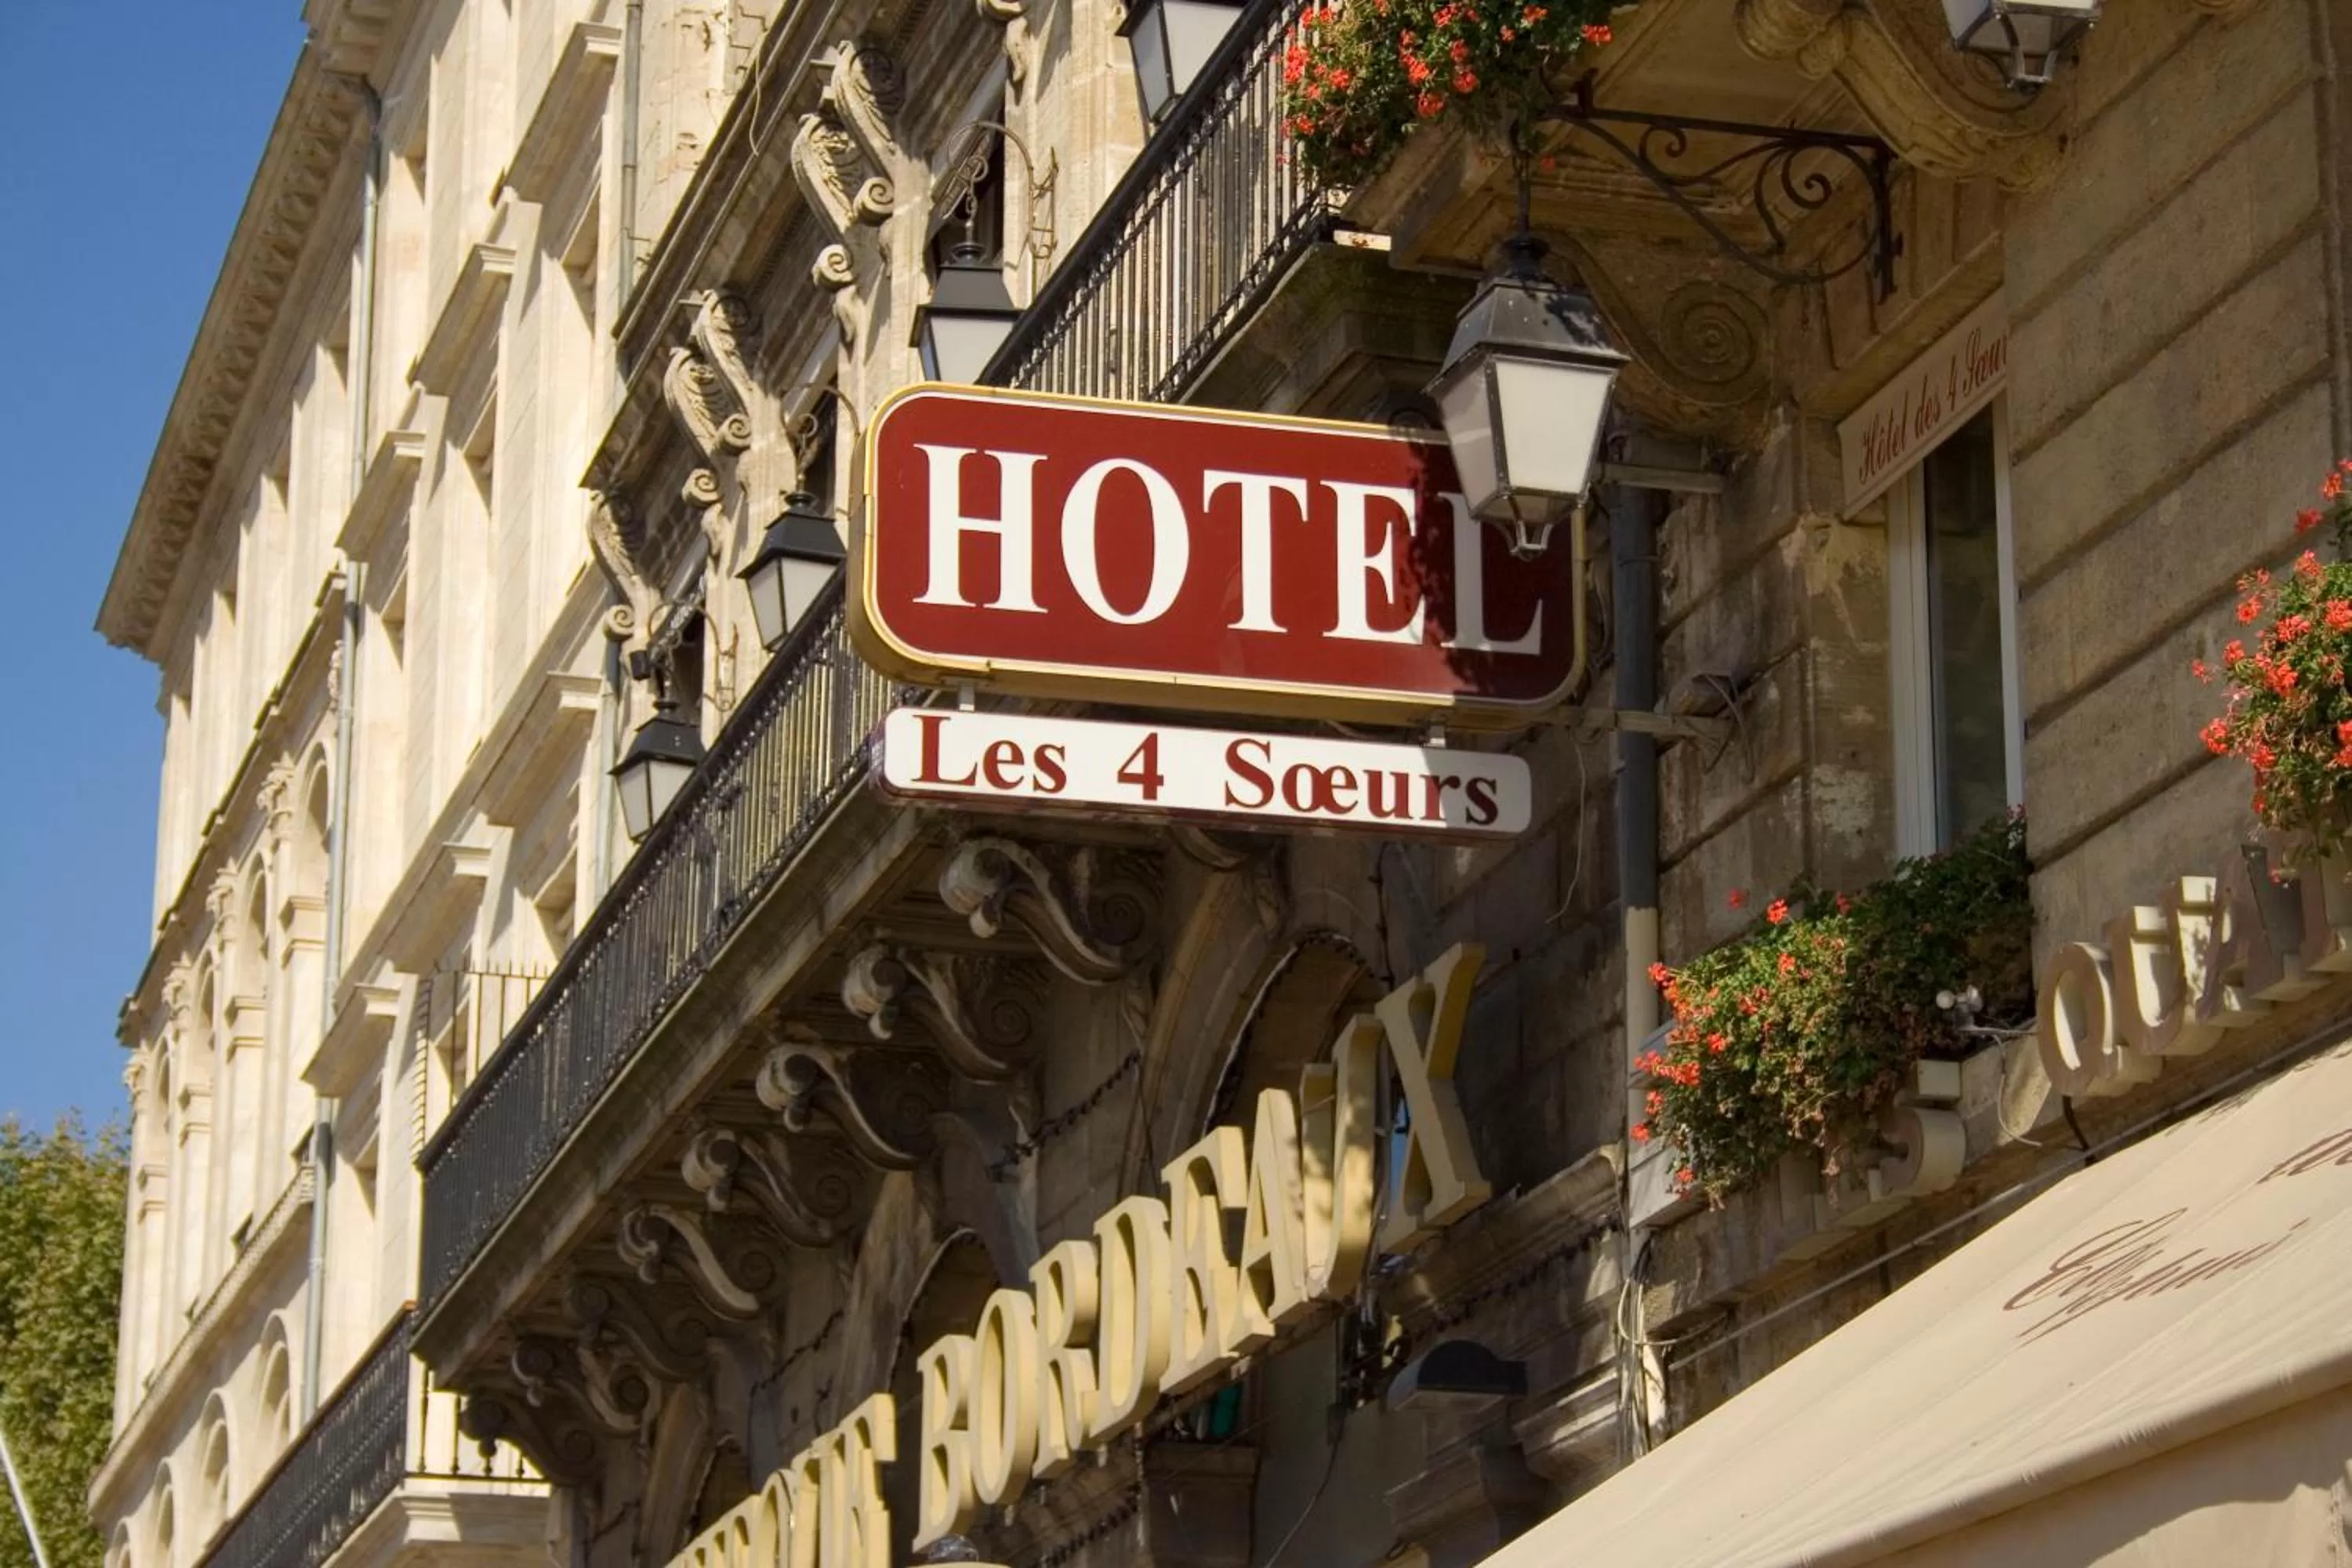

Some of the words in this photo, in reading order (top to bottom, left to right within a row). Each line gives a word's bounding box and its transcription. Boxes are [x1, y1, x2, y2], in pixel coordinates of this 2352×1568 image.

[1858, 389, 1909, 485] Hôtel
[1915, 372, 1941, 439] des
[1947, 354, 1958, 412] 4
[912, 443, 1543, 655] HOTEL
[911, 714, 1067, 793] Les
[1117, 732, 1164, 800] 4
[1224, 738, 1498, 826] Sœurs
[912, 941, 1493, 1552] BORDEAUX
